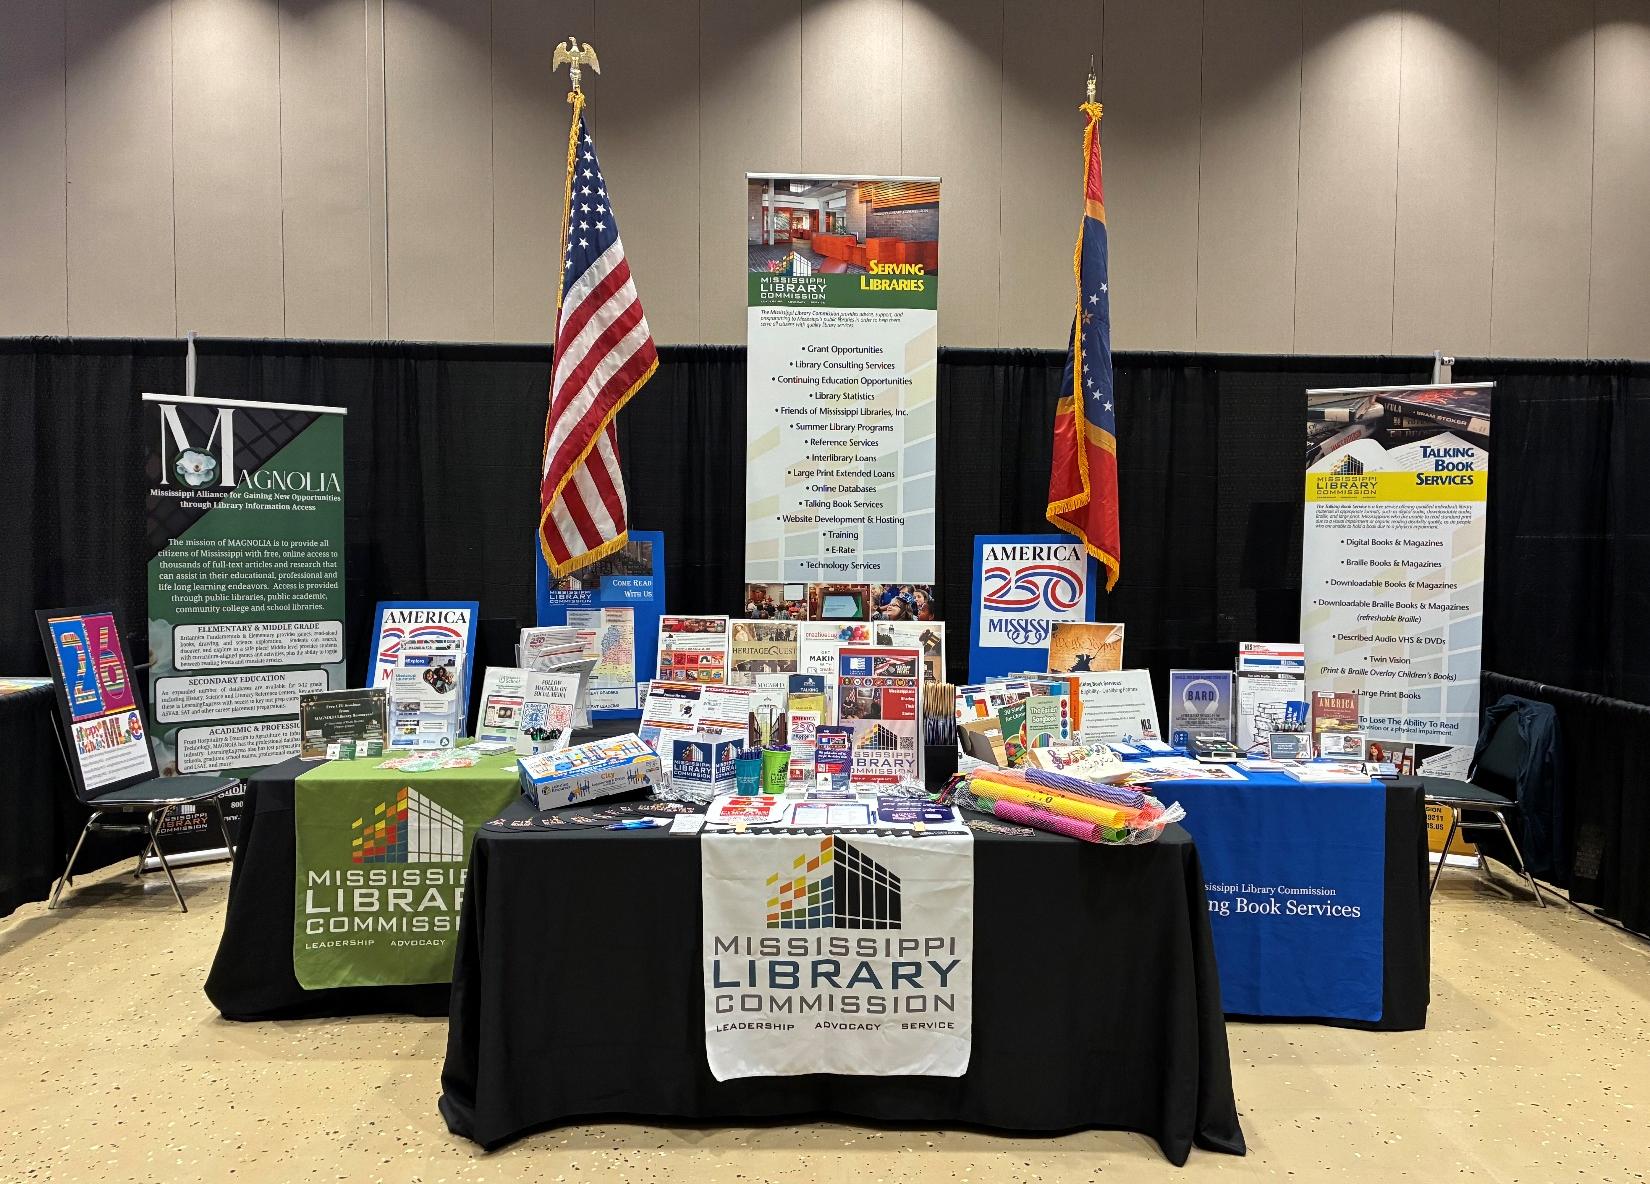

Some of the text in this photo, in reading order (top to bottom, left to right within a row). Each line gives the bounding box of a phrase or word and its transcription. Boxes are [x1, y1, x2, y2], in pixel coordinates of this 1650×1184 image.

[869, 260, 924, 276] SERVING
[761, 284, 827, 293] LIBRARY
[860, 276, 924, 291] LIBRARIES
[831, 346, 883, 355] Opportunities
[796, 361, 895, 371] Library Consulting Services
[778, 376, 913, 386] Continuing Education Opportunities
[815, 392, 875, 402] Library Statistics
[820, 408, 859, 417] Mississippi
[860, 408, 894, 417] Libraries,
[896, 408, 909, 416] Inc.
[796, 423, 894, 433] Summer Library Programs
[810, 439, 879, 447] Reference Services
[1419, 446, 1475, 459] TALKING
[812, 454, 854, 464] Interlibrary
[1434, 460, 1474, 472] BOOK
[794, 469, 895, 479] Large Print Extended Loans
[1416, 473, 1474, 486] SERVICES
[812, 485, 877, 493] Online Databases
[150, 489, 195, 499] Mississippi
[196, 490, 229, 500] Alliance
[229, 491, 242, 499] for
[244, 492, 272, 501] Gaining
[292, 494, 341, 502] Opportunities
[180, 500, 212, 510] through
[214, 501, 243, 510] Library
[245, 502, 290, 510] Information
[804, 501, 831, 510] Talking
[854, 501, 884, 509] Services
[782, 515, 906, 525] Website Development Hosting
[828, 531, 859, 541] Training
[168, 539, 184, 548] The
[186, 539, 216, 547] mission
[227, 539, 272, 547] MAGNOLIA
[290, 540, 318, 549] provide
[1346, 539, 1370, 548] Digital
[1403, 539, 1444, 548] Magazines
[986, 546, 1080, 561] AMERICA
[806, 562, 881, 571] Technology Services
[1402, 560, 1442, 569] Magazines
[984, 564, 1084, 612] 250
[1330, 579, 1458, 590] Downloadable Books Magazines
[1318, 599, 1469, 612] Downloadable Braille Books Magazines
[384, 610, 467, 624] AMERICA
[1357, 615, 1422, 624] (refreshable Braille)
[198, 625, 253, 633] ELEMENTARY
[1338, 634, 1446, 645] Described Audio VHS DVDs
[1388, 656, 1412, 665] Vision
[189, 674, 285, 686] SECONDARY EDUCATION
[1348, 668, 1369, 676] Braille
[1370, 669, 1397, 679] Overlay
[1398, 670, 1432, 680] Children's
[1433, 672, 1457, 681] Books)
[1187, 691, 1214, 701] BARD
[1357, 689, 1421, 700] Large Print Books
[1319, 698, 1354, 709] AMERICA
[1141, 719, 1152, 730] NLS
[1359, 716, 1459, 730] To Lose The Ability To Read
[209, 726, 252, 736] ACADEMIC
[1241, 884, 1276, 896] Library
[1278, 886, 1336, 896] Commission
[1235, 898, 1282, 915] Book
[1286, 900, 1361, 918] Services
[306, 939, 375, 950] LEADERSHIP
[715, 936, 956, 958] MISSISSIPPI
[713, 959, 961, 990] LIBRARY
[716, 994, 955, 1015] COMMISSION
[716, 1022, 954, 1033] LEADERSHIP ADVOCACY SERVICE
